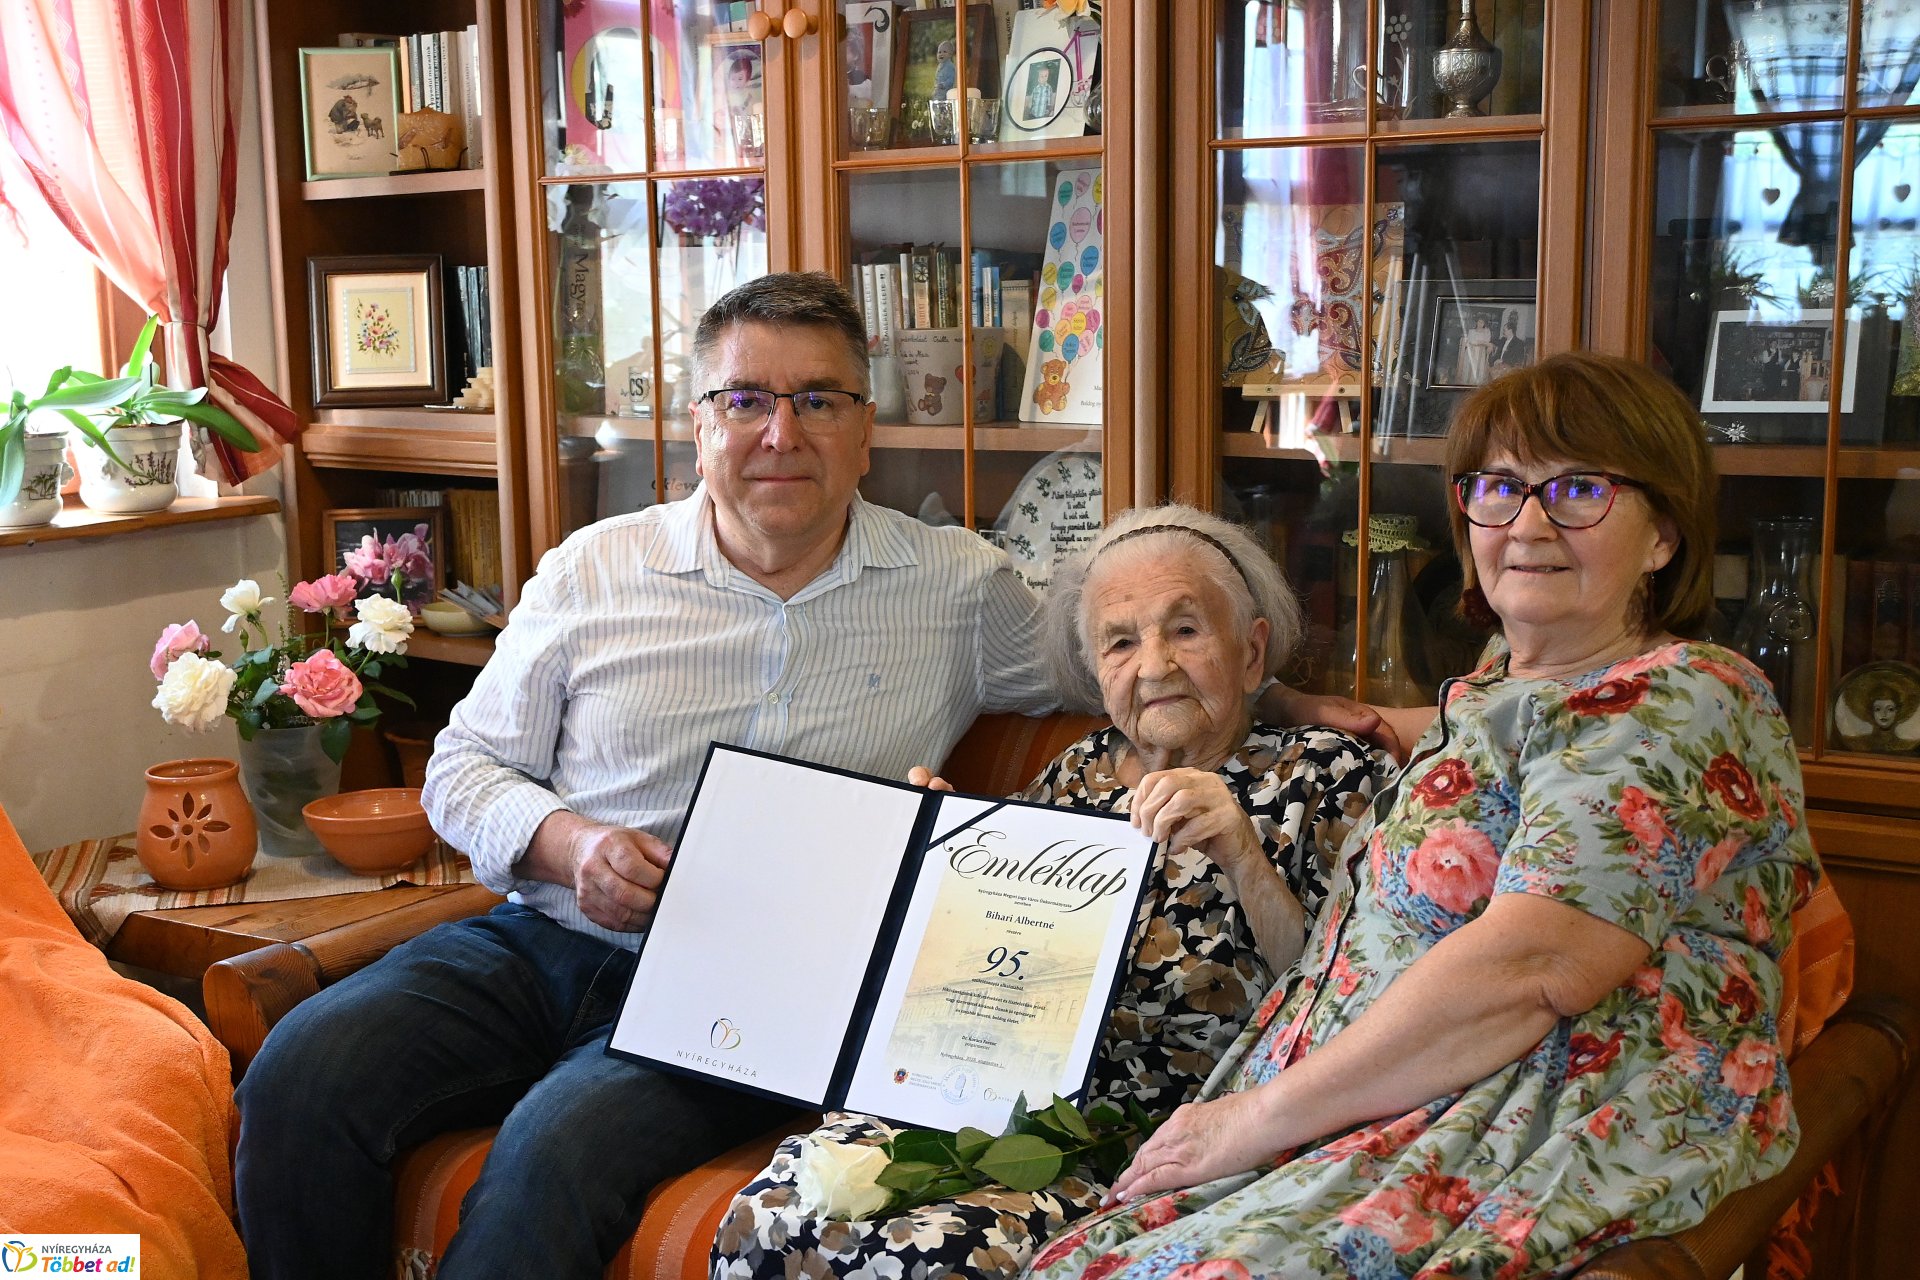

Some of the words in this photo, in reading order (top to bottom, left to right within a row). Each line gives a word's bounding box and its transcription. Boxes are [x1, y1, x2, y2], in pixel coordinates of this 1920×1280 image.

[942, 826, 1128, 913] Emléklap
[986, 910, 1013, 922] Bihari
[1014, 914, 1055, 930] Albertné
[978, 946, 1029, 980] 95.
[676, 1050, 757, 1078] NYÍREGYHÁZA
